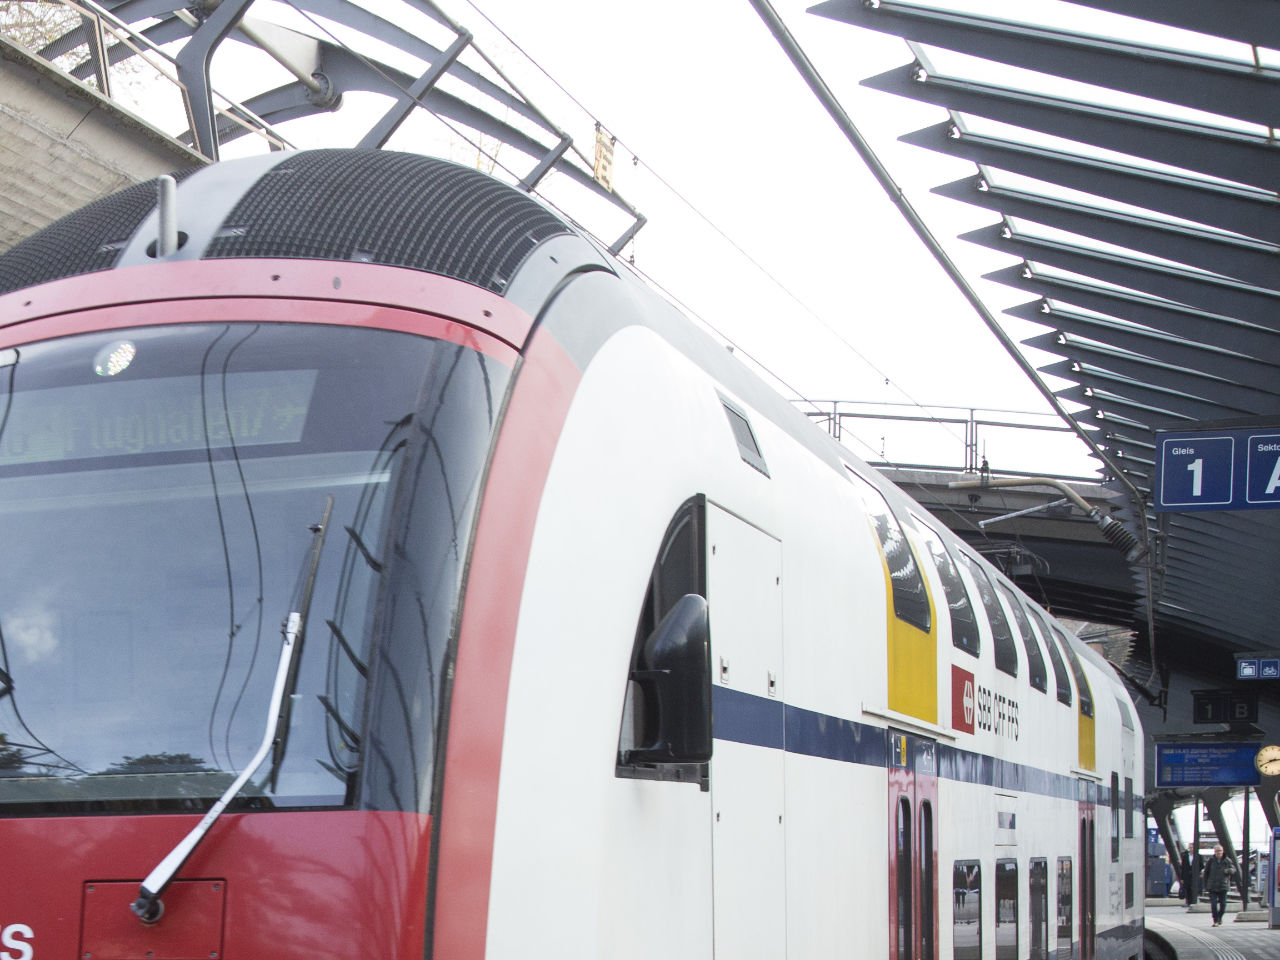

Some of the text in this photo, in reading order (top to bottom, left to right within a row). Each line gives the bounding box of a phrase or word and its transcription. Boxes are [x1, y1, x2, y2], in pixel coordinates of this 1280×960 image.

[1172, 447, 1195, 455] Gleis
[1187, 458, 1203, 496] 1
[977, 684, 1019, 741] SBB CFF FFS
[1205, 703, 1213, 719] 1
[1235, 703, 1249, 718] B
